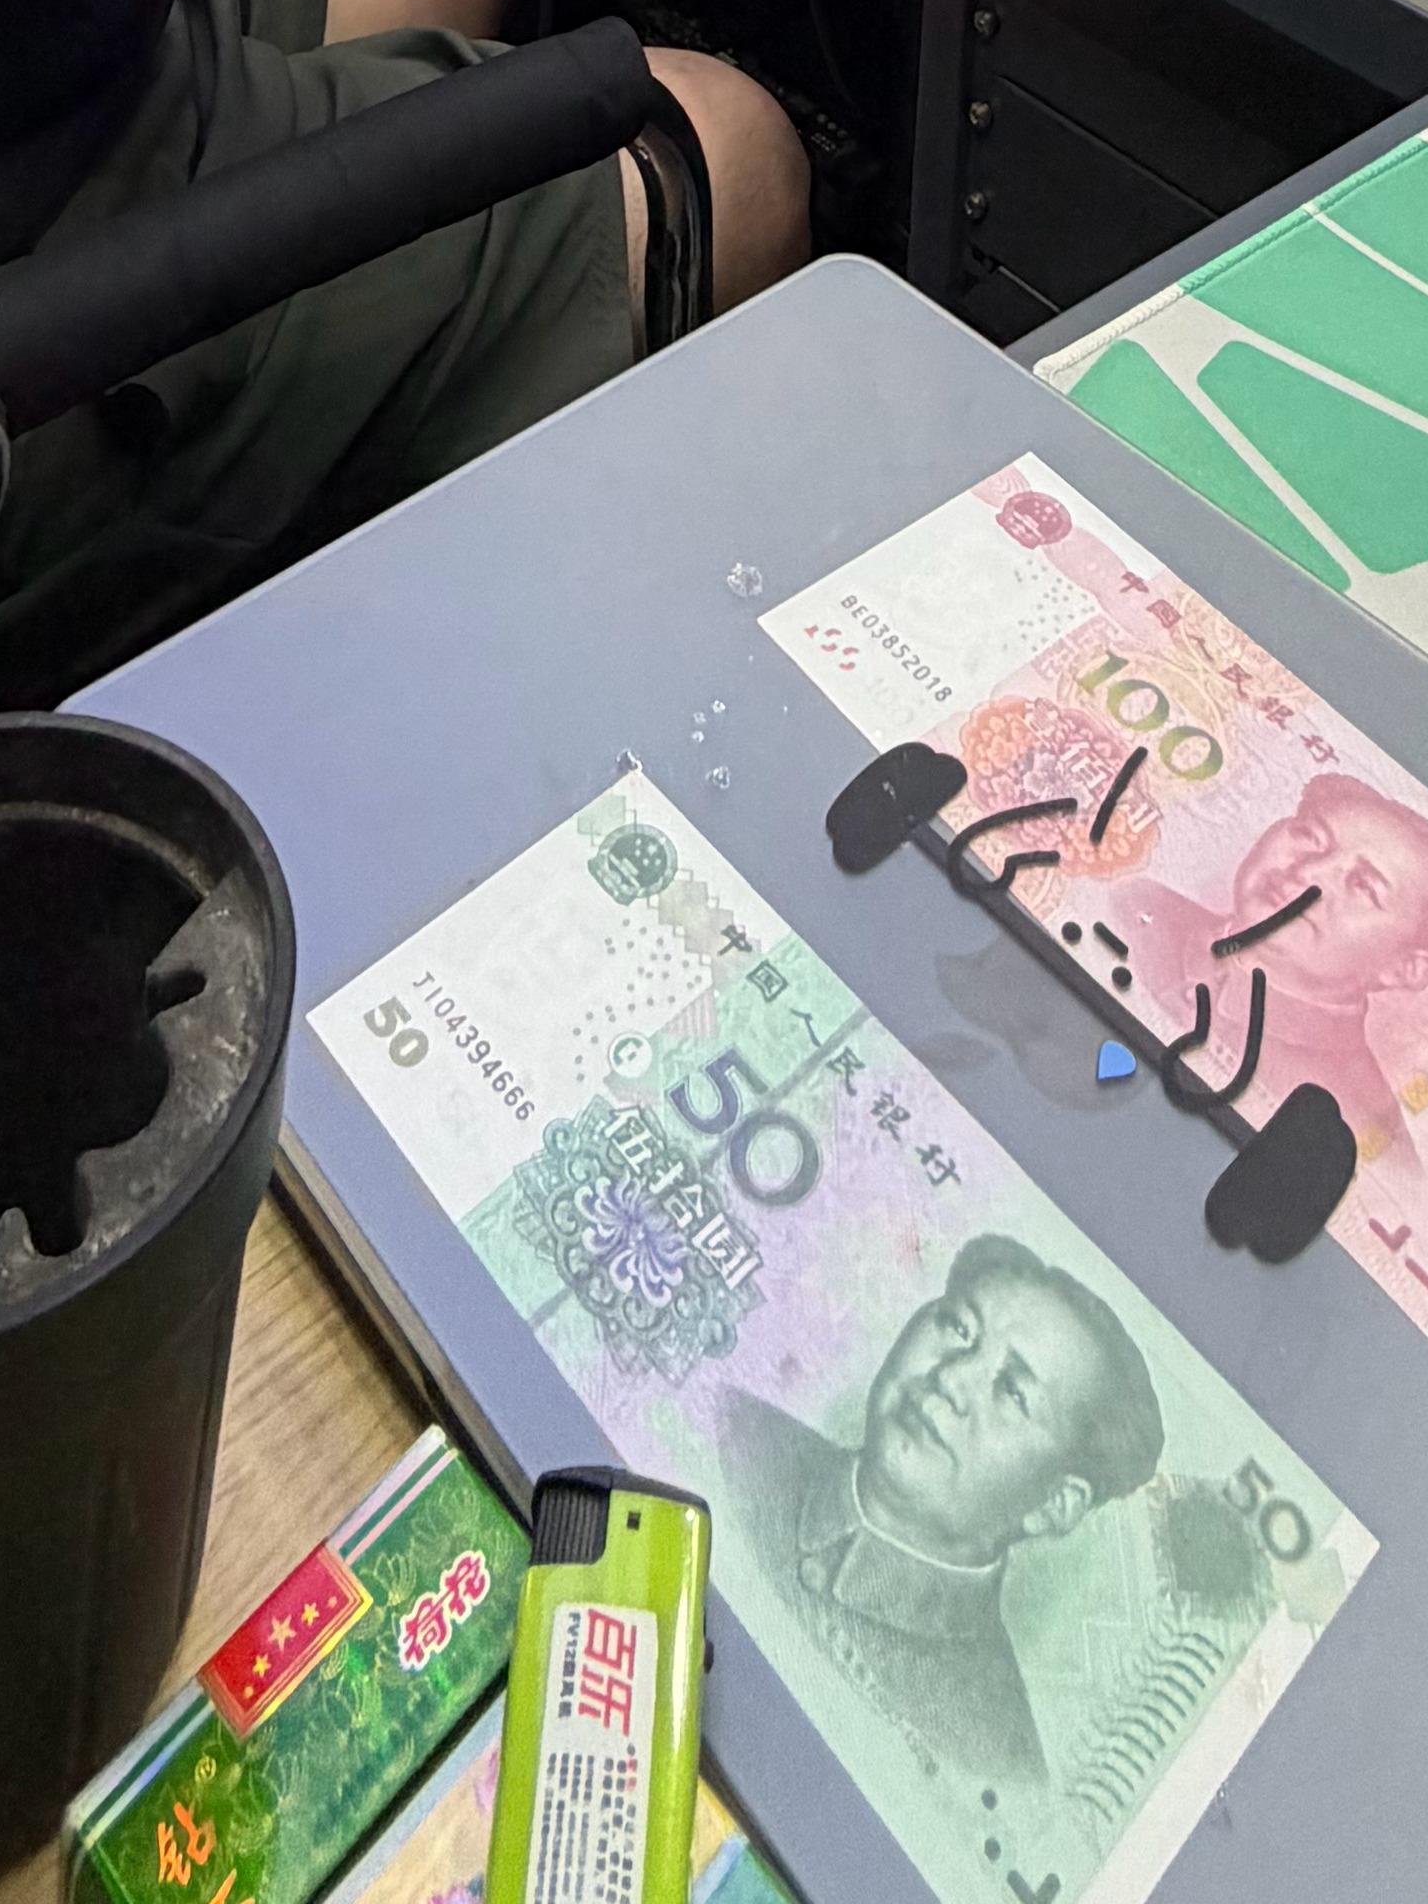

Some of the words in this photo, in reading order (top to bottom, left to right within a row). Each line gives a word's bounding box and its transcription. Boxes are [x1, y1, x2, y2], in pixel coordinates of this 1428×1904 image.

[838, 593, 955, 704] BE03852018
[1118, 570, 1341, 766] 中国人民银行
[1076, 647, 1226, 783] 100
[362, 994, 430, 1070] 50
[717, 922, 961, 1189] 中国人民银行
[668, 1044, 823, 1210] 50
[1220, 1456, 1314, 1566] 50
[398, 1548, 492, 1672] 荷花
